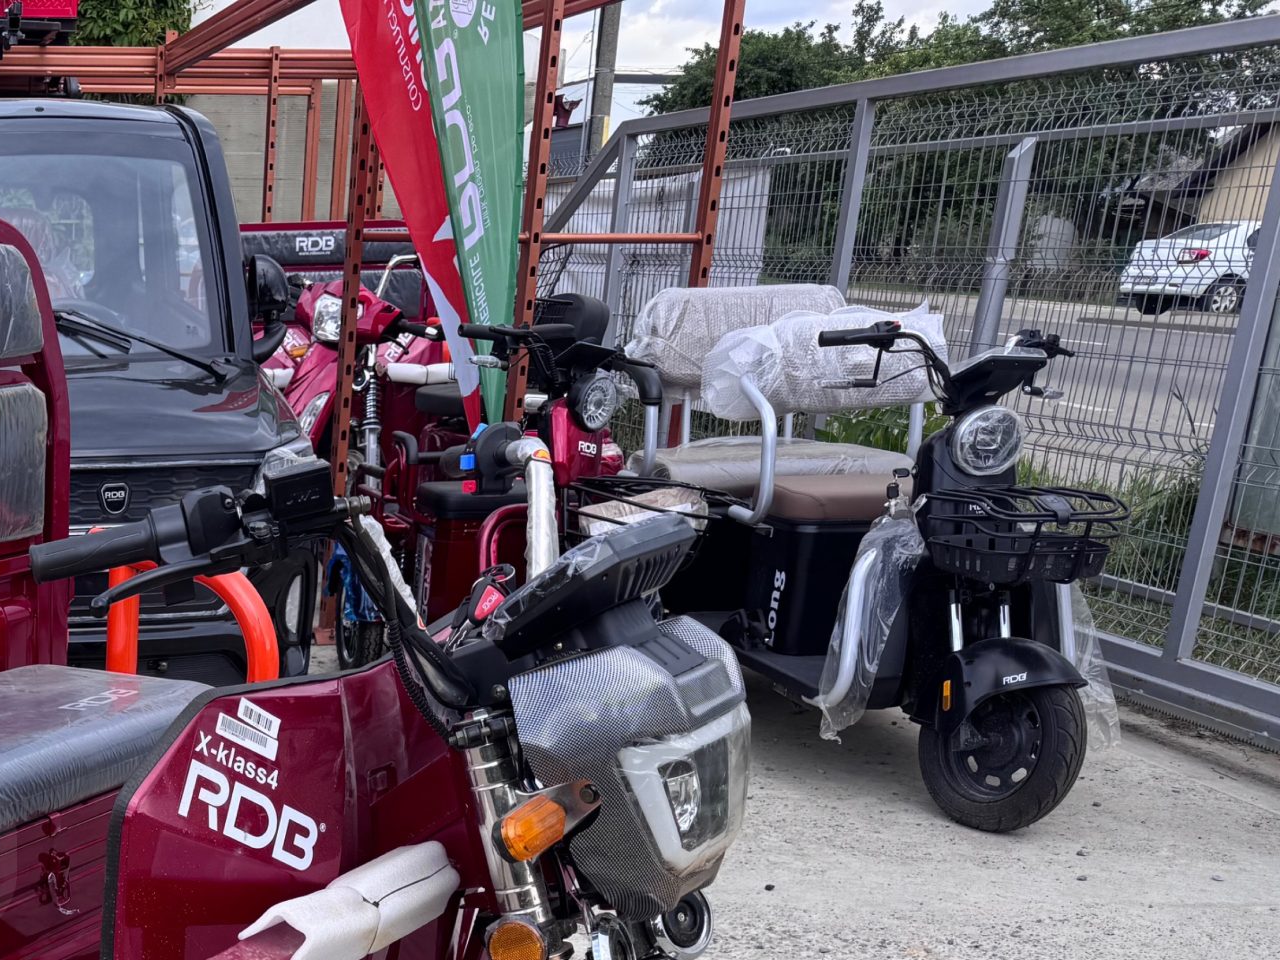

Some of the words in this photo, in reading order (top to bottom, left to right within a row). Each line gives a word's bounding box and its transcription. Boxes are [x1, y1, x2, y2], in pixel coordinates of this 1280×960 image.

[296, 236, 335, 252] RDB
[104, 490, 125, 499] RDB
[195, 730, 279, 790] X-klass4
[178, 758, 318, 871] RDB
